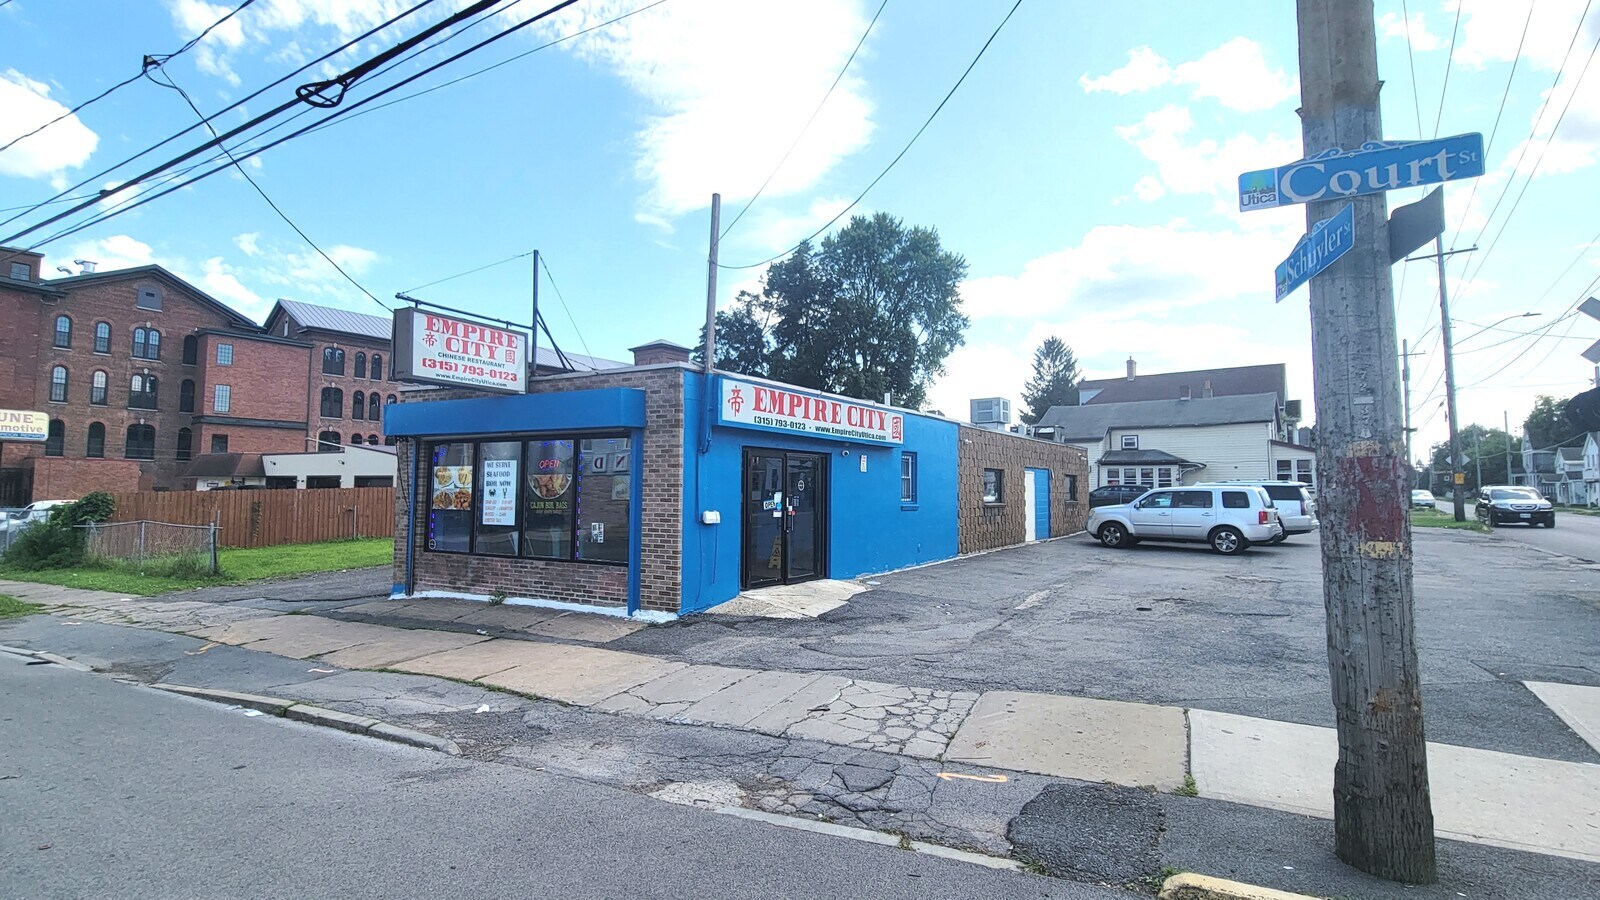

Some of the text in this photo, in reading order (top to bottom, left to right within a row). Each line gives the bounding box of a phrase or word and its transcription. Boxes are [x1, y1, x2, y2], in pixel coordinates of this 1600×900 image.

[1280, 148, 1478, 200] Court St
[1241, 193, 1276, 206] Utica
[1287, 221, 1351, 284] Schuyler St
[425, 314, 518, 350] EMPIRE
[445, 336, 498, 360] CITY
[422, 357, 518, 382] (315) 793-0123
[437, 352, 506, 369] CHINESE RESTAURANT
[435, 372, 508, 388] www.EmpireCityUtica.com
[752, 386, 888, 431] EMPIRE CITY
[1, 424, 43, 433] motive
[754, 416, 887, 442] (315) 793-0123 www.EmpireCityUtica.com
[486, 461, 511, 469] WE SERVE
[486, 470, 511, 478] SEAFOOD
[539, 459, 560, 469] OPEN
